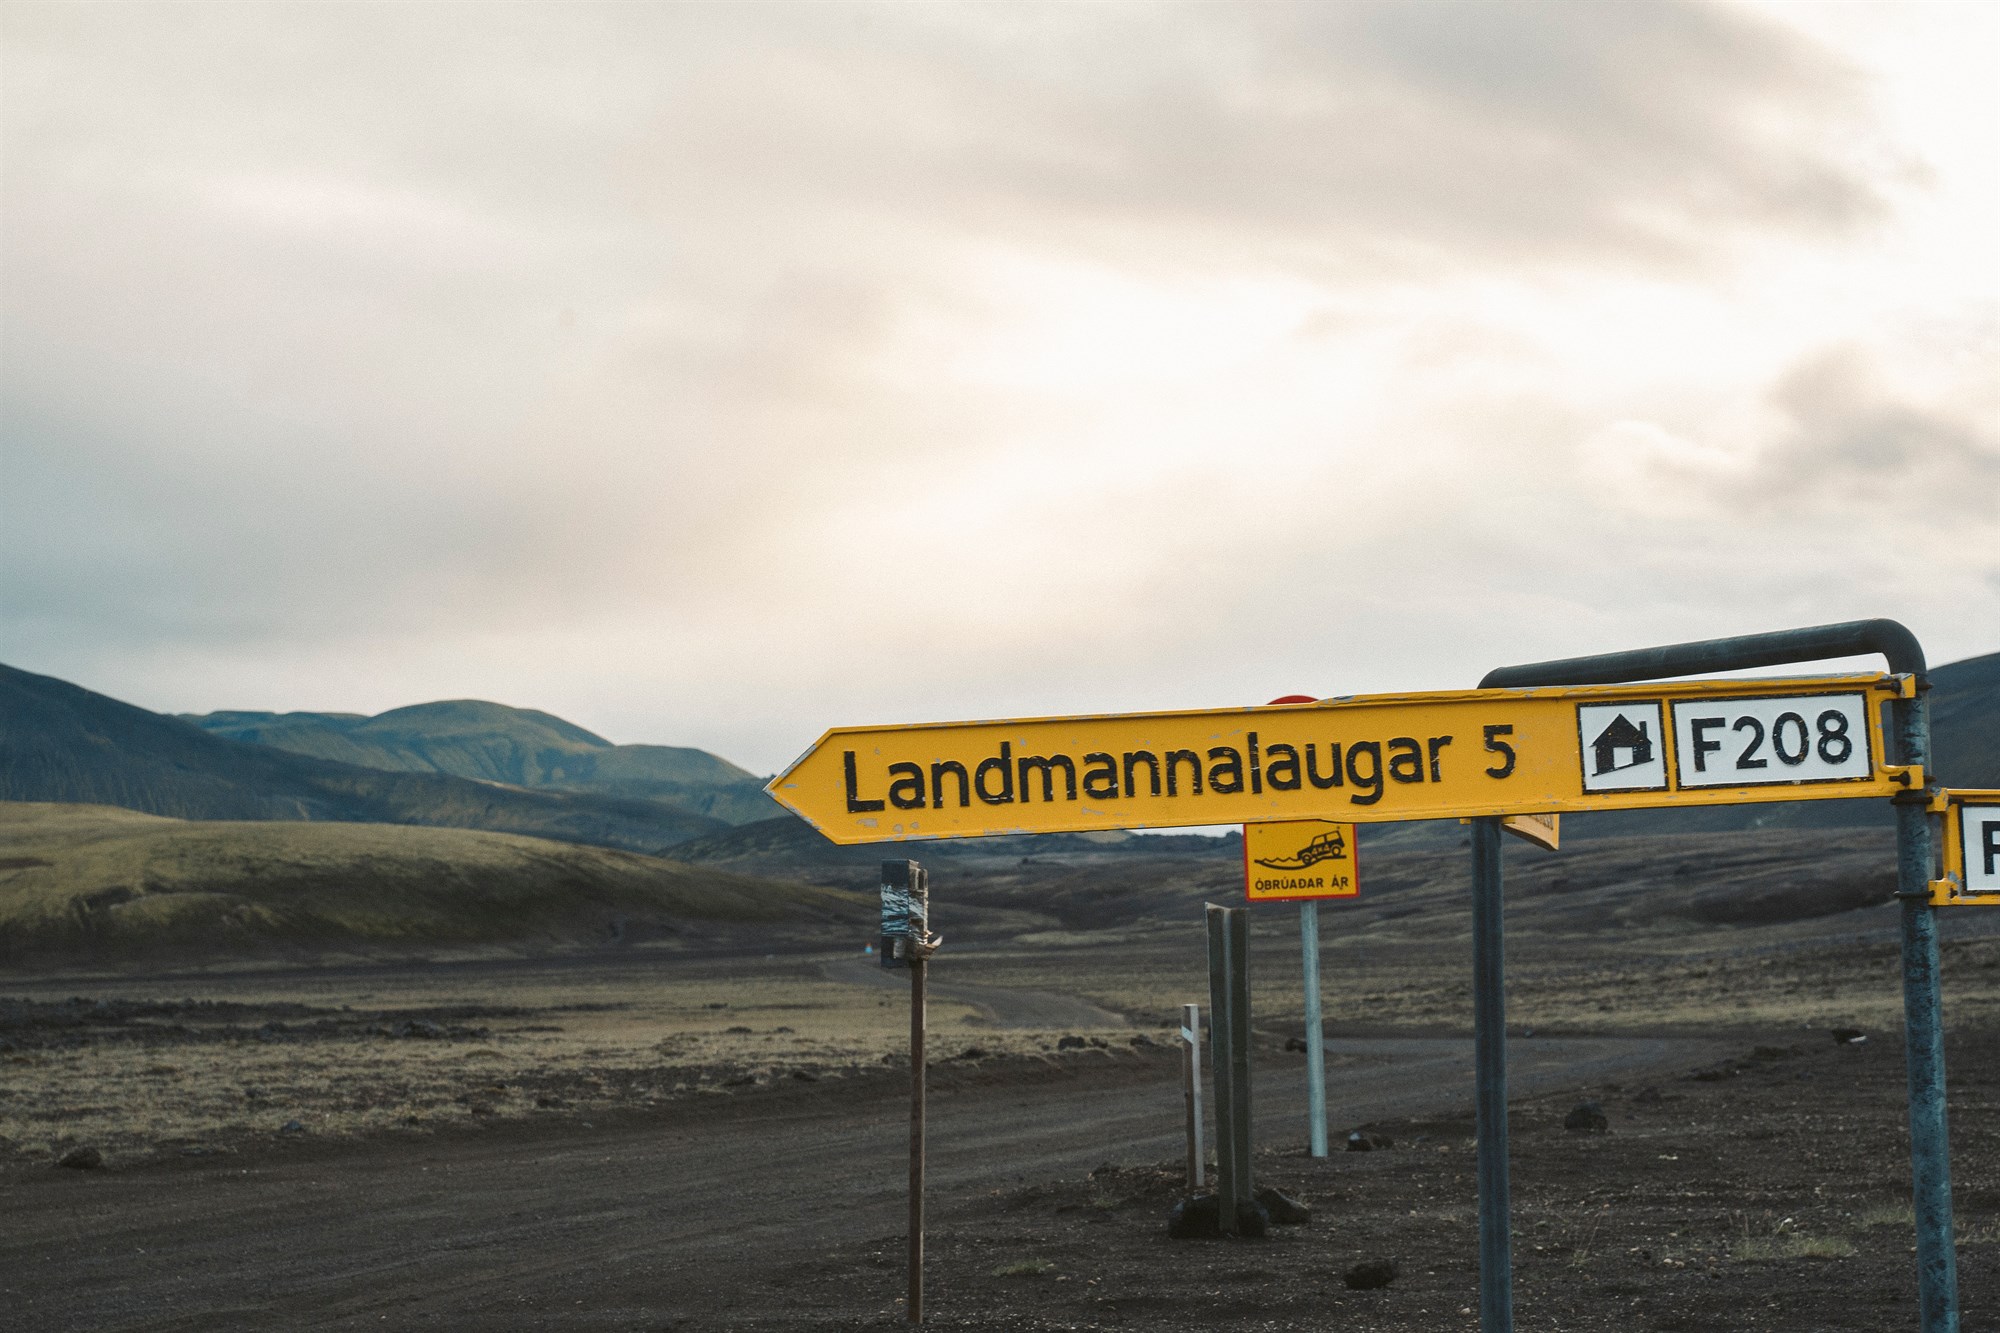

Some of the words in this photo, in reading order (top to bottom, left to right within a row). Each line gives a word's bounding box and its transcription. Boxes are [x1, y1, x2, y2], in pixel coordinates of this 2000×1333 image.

[844, 731, 1453, 813] Landmannalaugar
[1483, 724, 1516, 779] 5
[1691, 709, 1853, 772] F208
[1255, 875, 1324, 891] ÓBRÚAÐAR
[1331, 874, 1348, 888] ÁR
